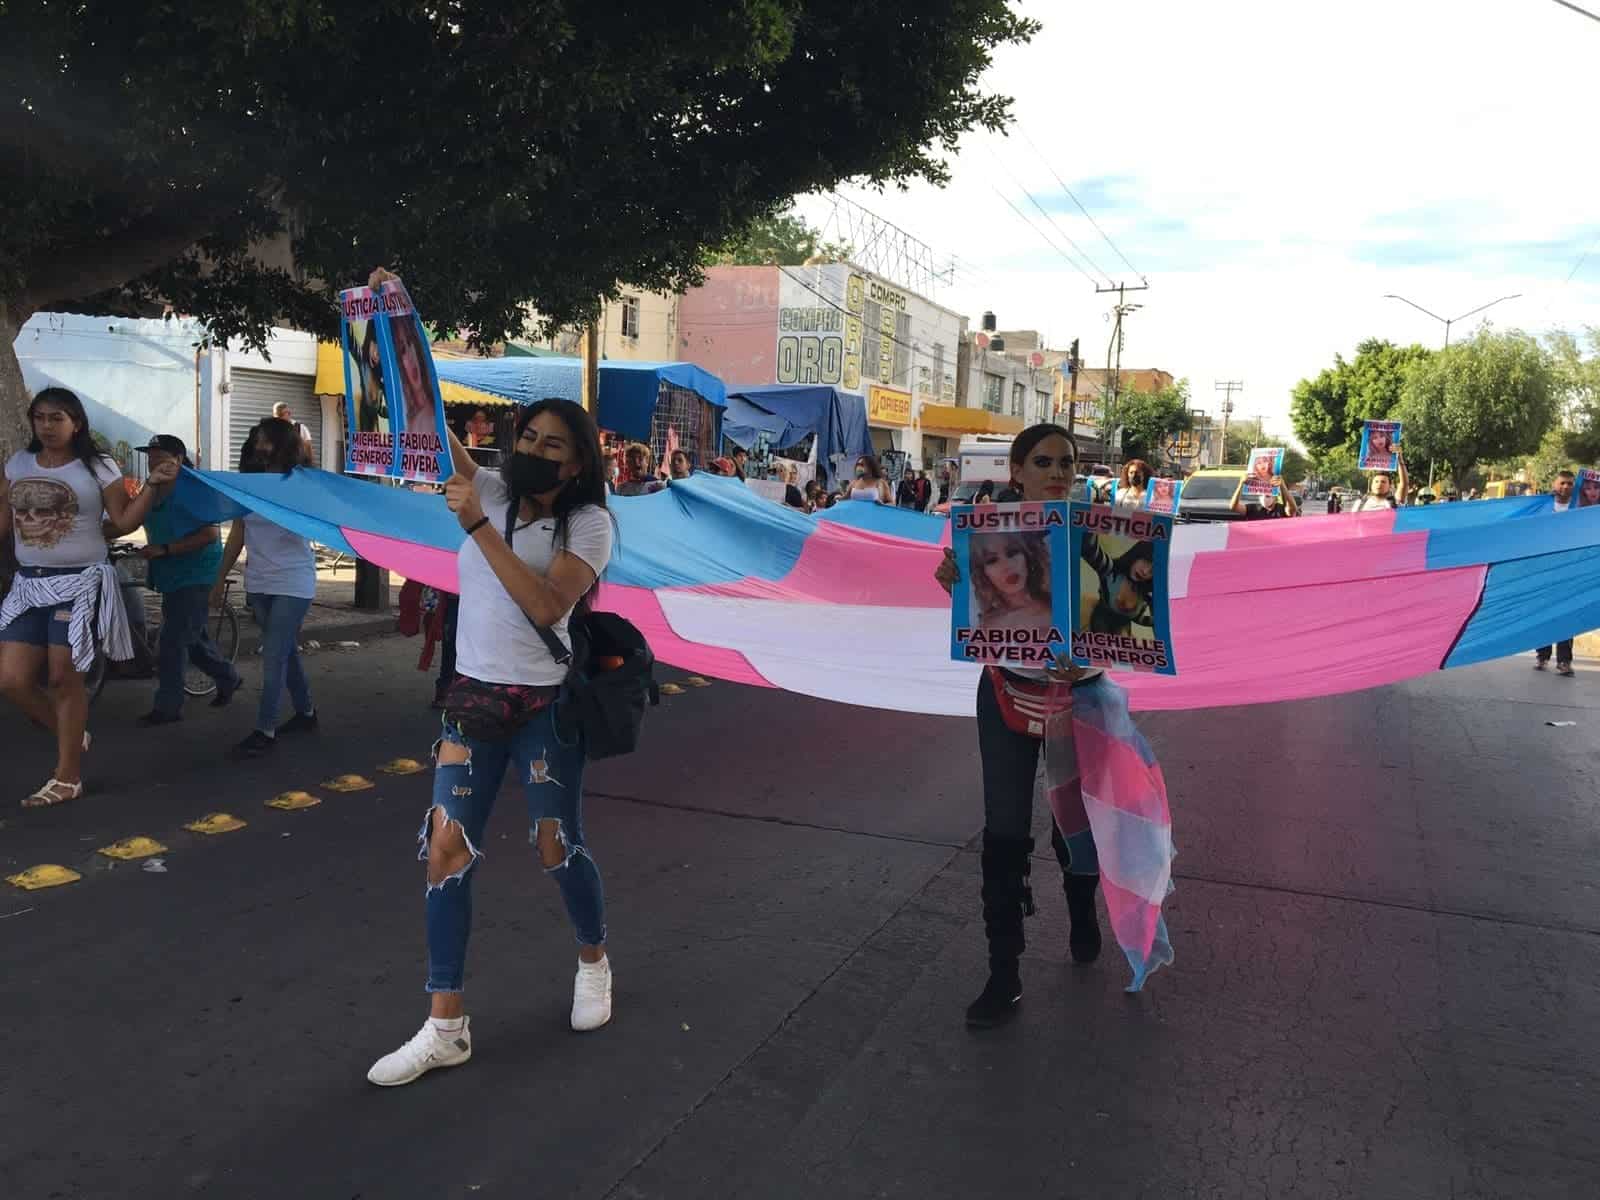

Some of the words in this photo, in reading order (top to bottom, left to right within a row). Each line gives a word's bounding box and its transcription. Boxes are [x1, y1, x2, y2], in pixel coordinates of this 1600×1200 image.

[341, 296, 379, 317] JUSTICIA
[870, 283, 906, 311] COMPRO
[779, 308, 843, 332] COMPRO
[843, 273, 865, 390] ORO
[777, 336, 843, 384] ORO
[351, 432, 393, 449] MICHELLE
[399, 432, 444, 453] FABIOLA
[350, 449, 393, 466] CISNEROS
[401, 454, 441, 474] RIVERA
[956, 510, 1064, 530] JUSTICIA
[1072, 510, 1169, 540] JUSTICIA
[957, 628, 1064, 645] FABIOLA
[1071, 631, 1165, 653] MICHELLE
[965, 645, 1057, 662] RIVERA
[1073, 646, 1168, 667] CISNEROS
